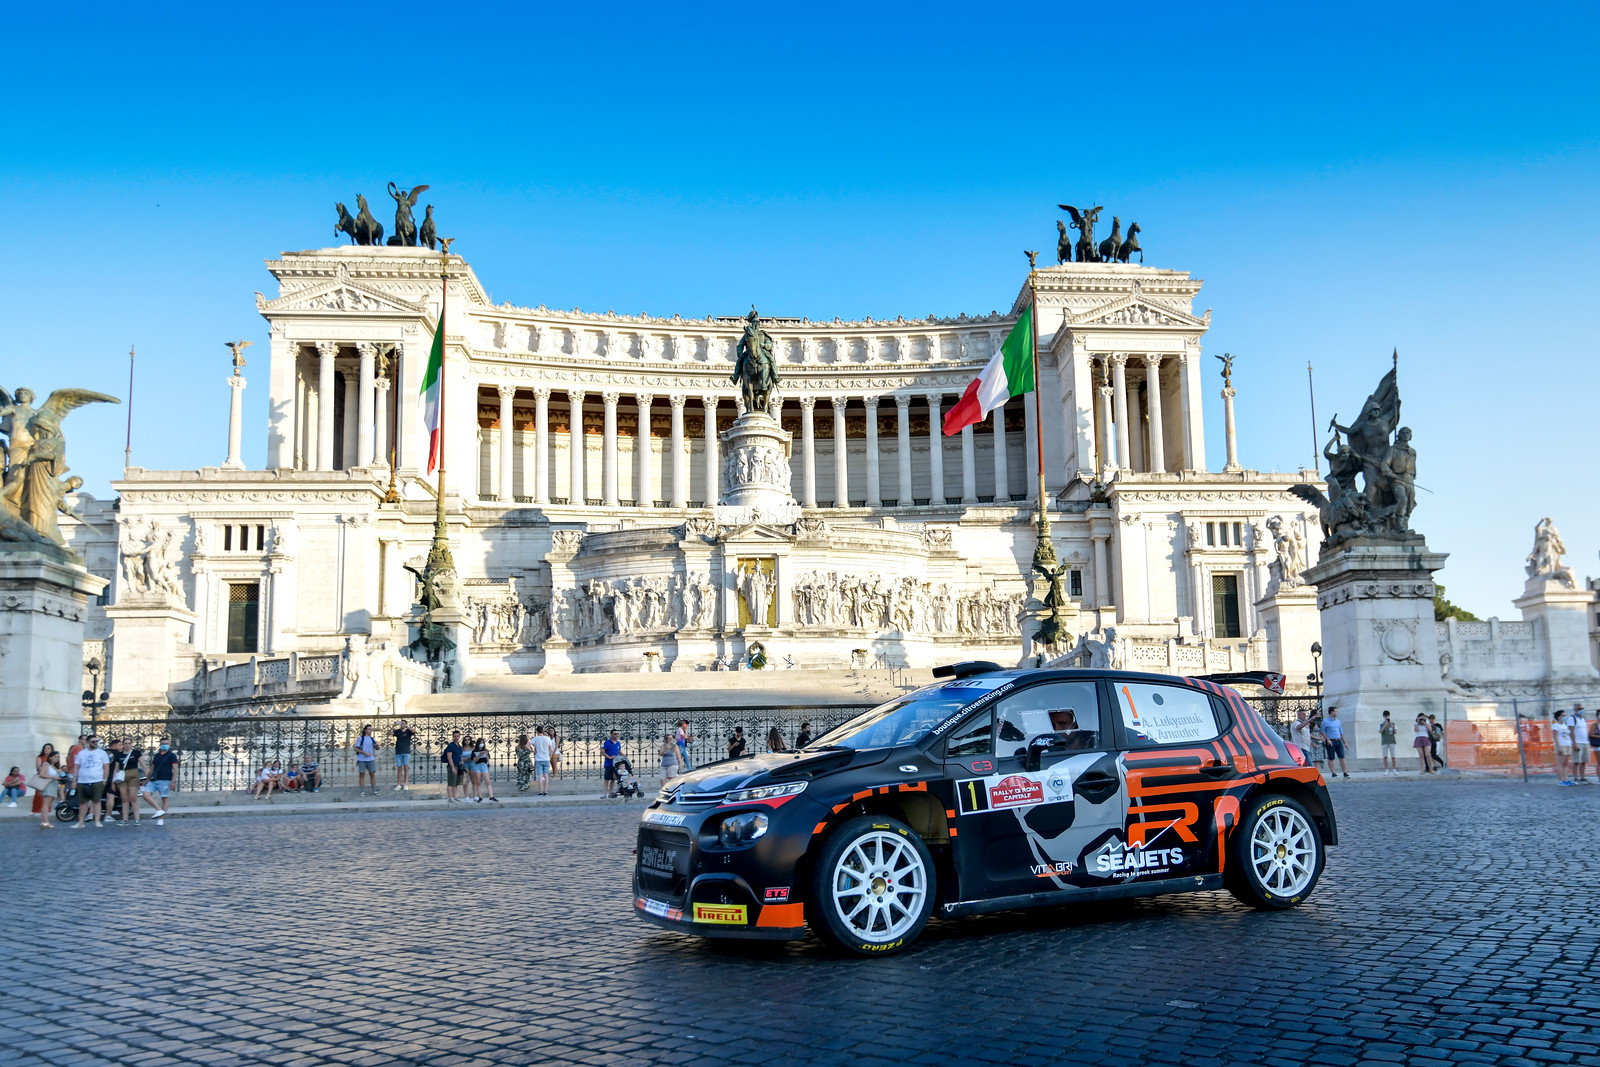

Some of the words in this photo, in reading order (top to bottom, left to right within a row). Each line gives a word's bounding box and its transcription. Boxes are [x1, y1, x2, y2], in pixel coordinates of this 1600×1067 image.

[932, 683, 1015, 735] boutique.citroenracing.com
[1122, 685, 1139, 719] 1
[1142, 717, 1153, 728] A.
[1153, 714, 1204, 729] Lukyanuk
[971, 760, 993, 772] C3
[968, 781, 978, 811] 1
[993, 789, 1013, 797] RALLY
[1003, 792, 1032, 801] CAPITALE
[1096, 847, 1184, 872] SEAJETS
[1030, 861, 1073, 875] VITABRI
[1136, 869, 1151, 877] greek
[1151, 867, 1170, 875] summer
[765, 888, 788, 898] ETS
[697, 906, 742, 921] PIRELLI
